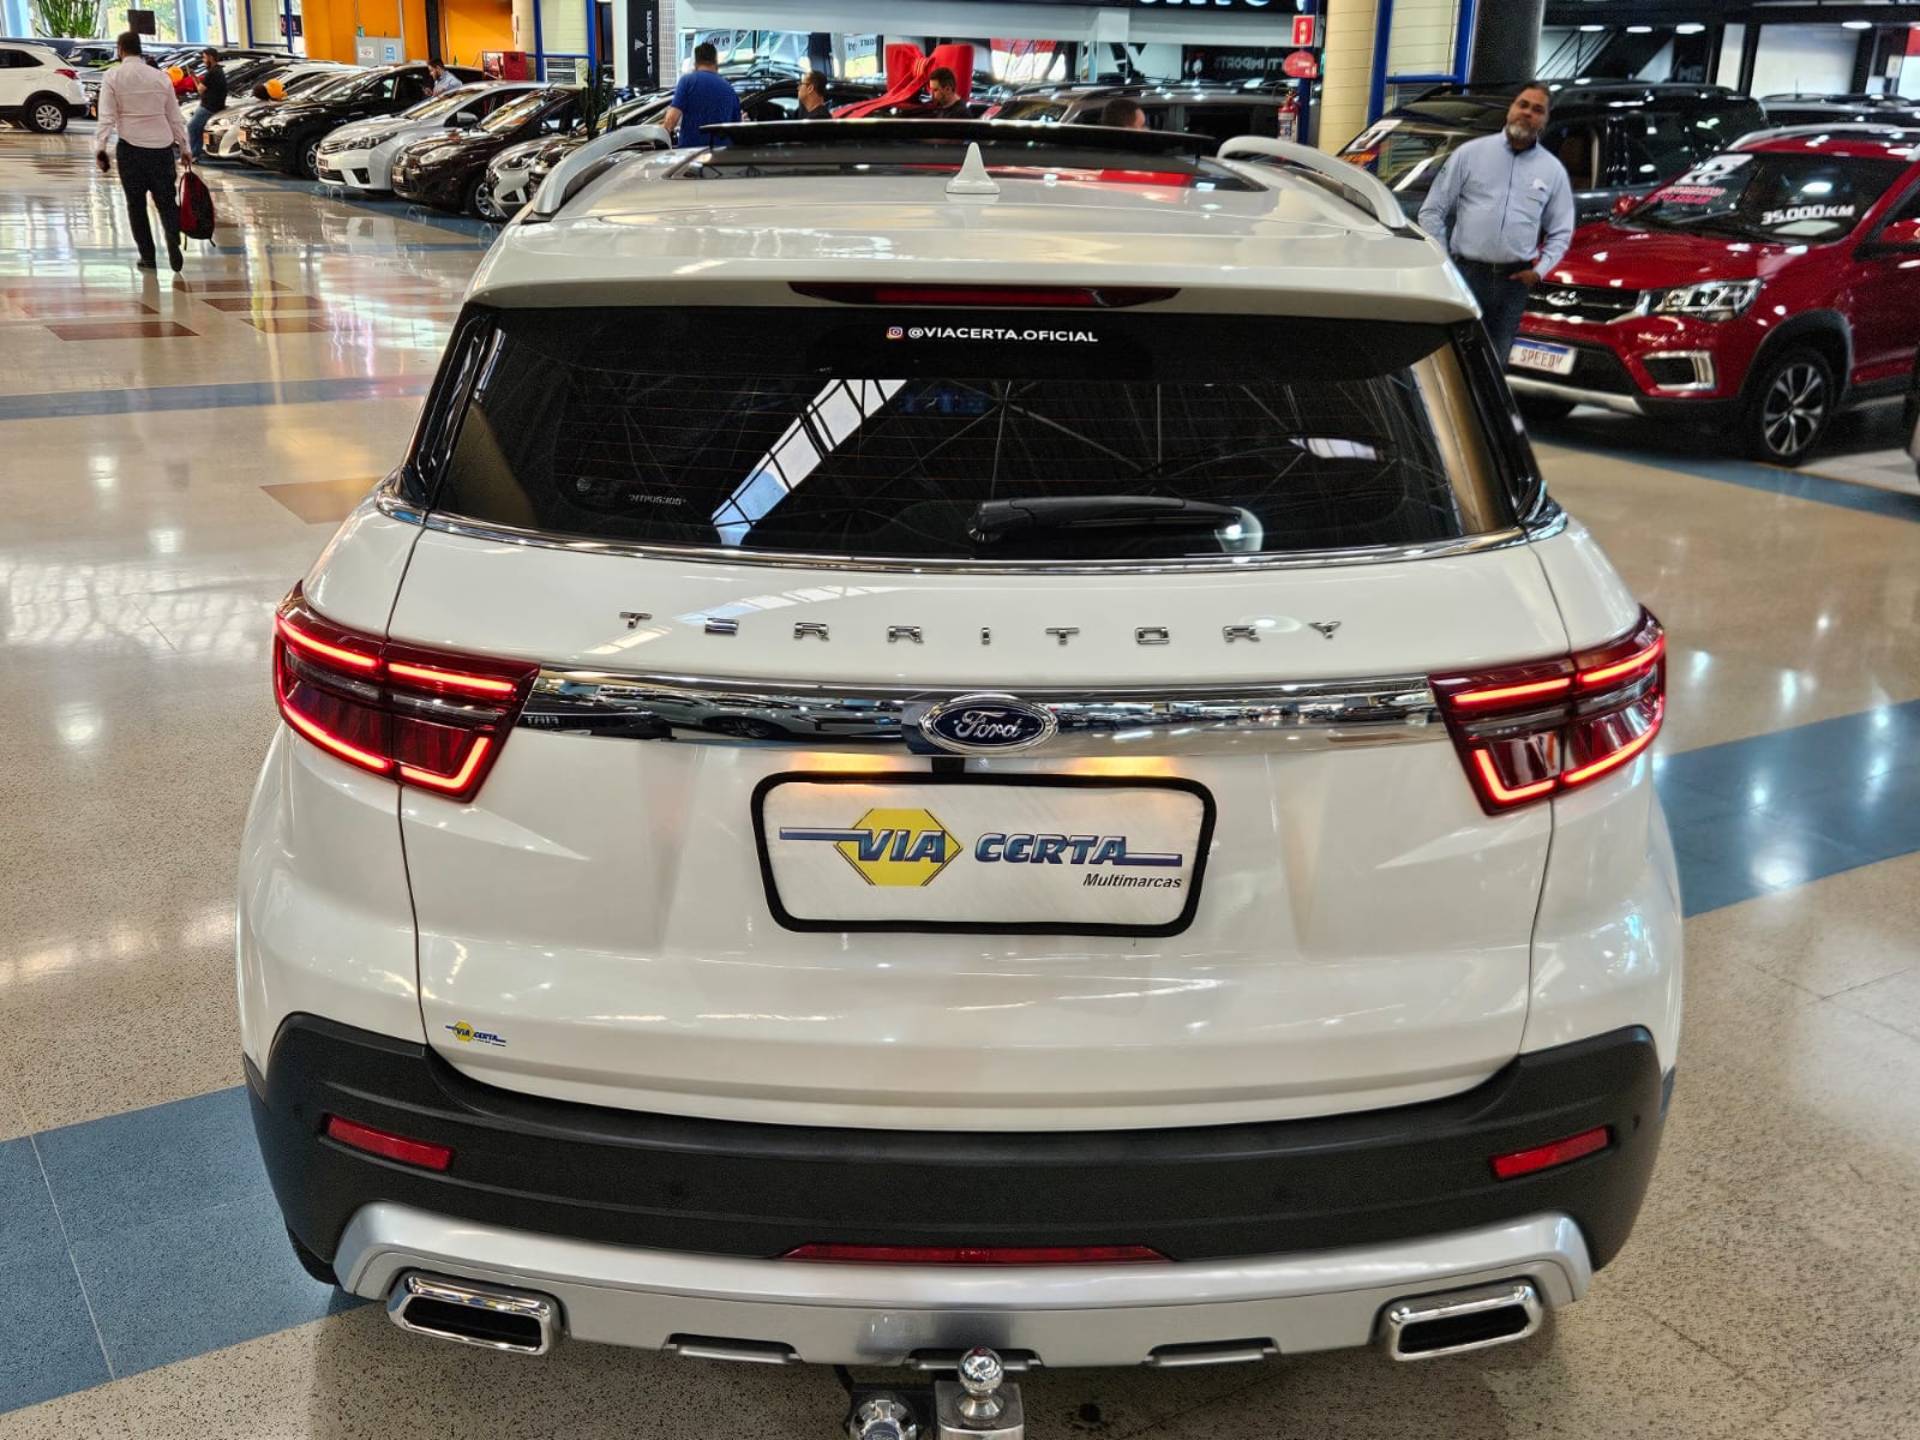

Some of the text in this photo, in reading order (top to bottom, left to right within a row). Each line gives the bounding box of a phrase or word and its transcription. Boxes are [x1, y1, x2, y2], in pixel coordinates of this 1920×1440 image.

[907, 326, 1099, 342] @VIACERTA.OFICIAL
[619, 611, 1342, 644] TERRITORY
[953, 710, 1025, 739] Ford
[858, 828, 946, 863] VIA
[1083, 872, 1182, 889] Multimarcas
